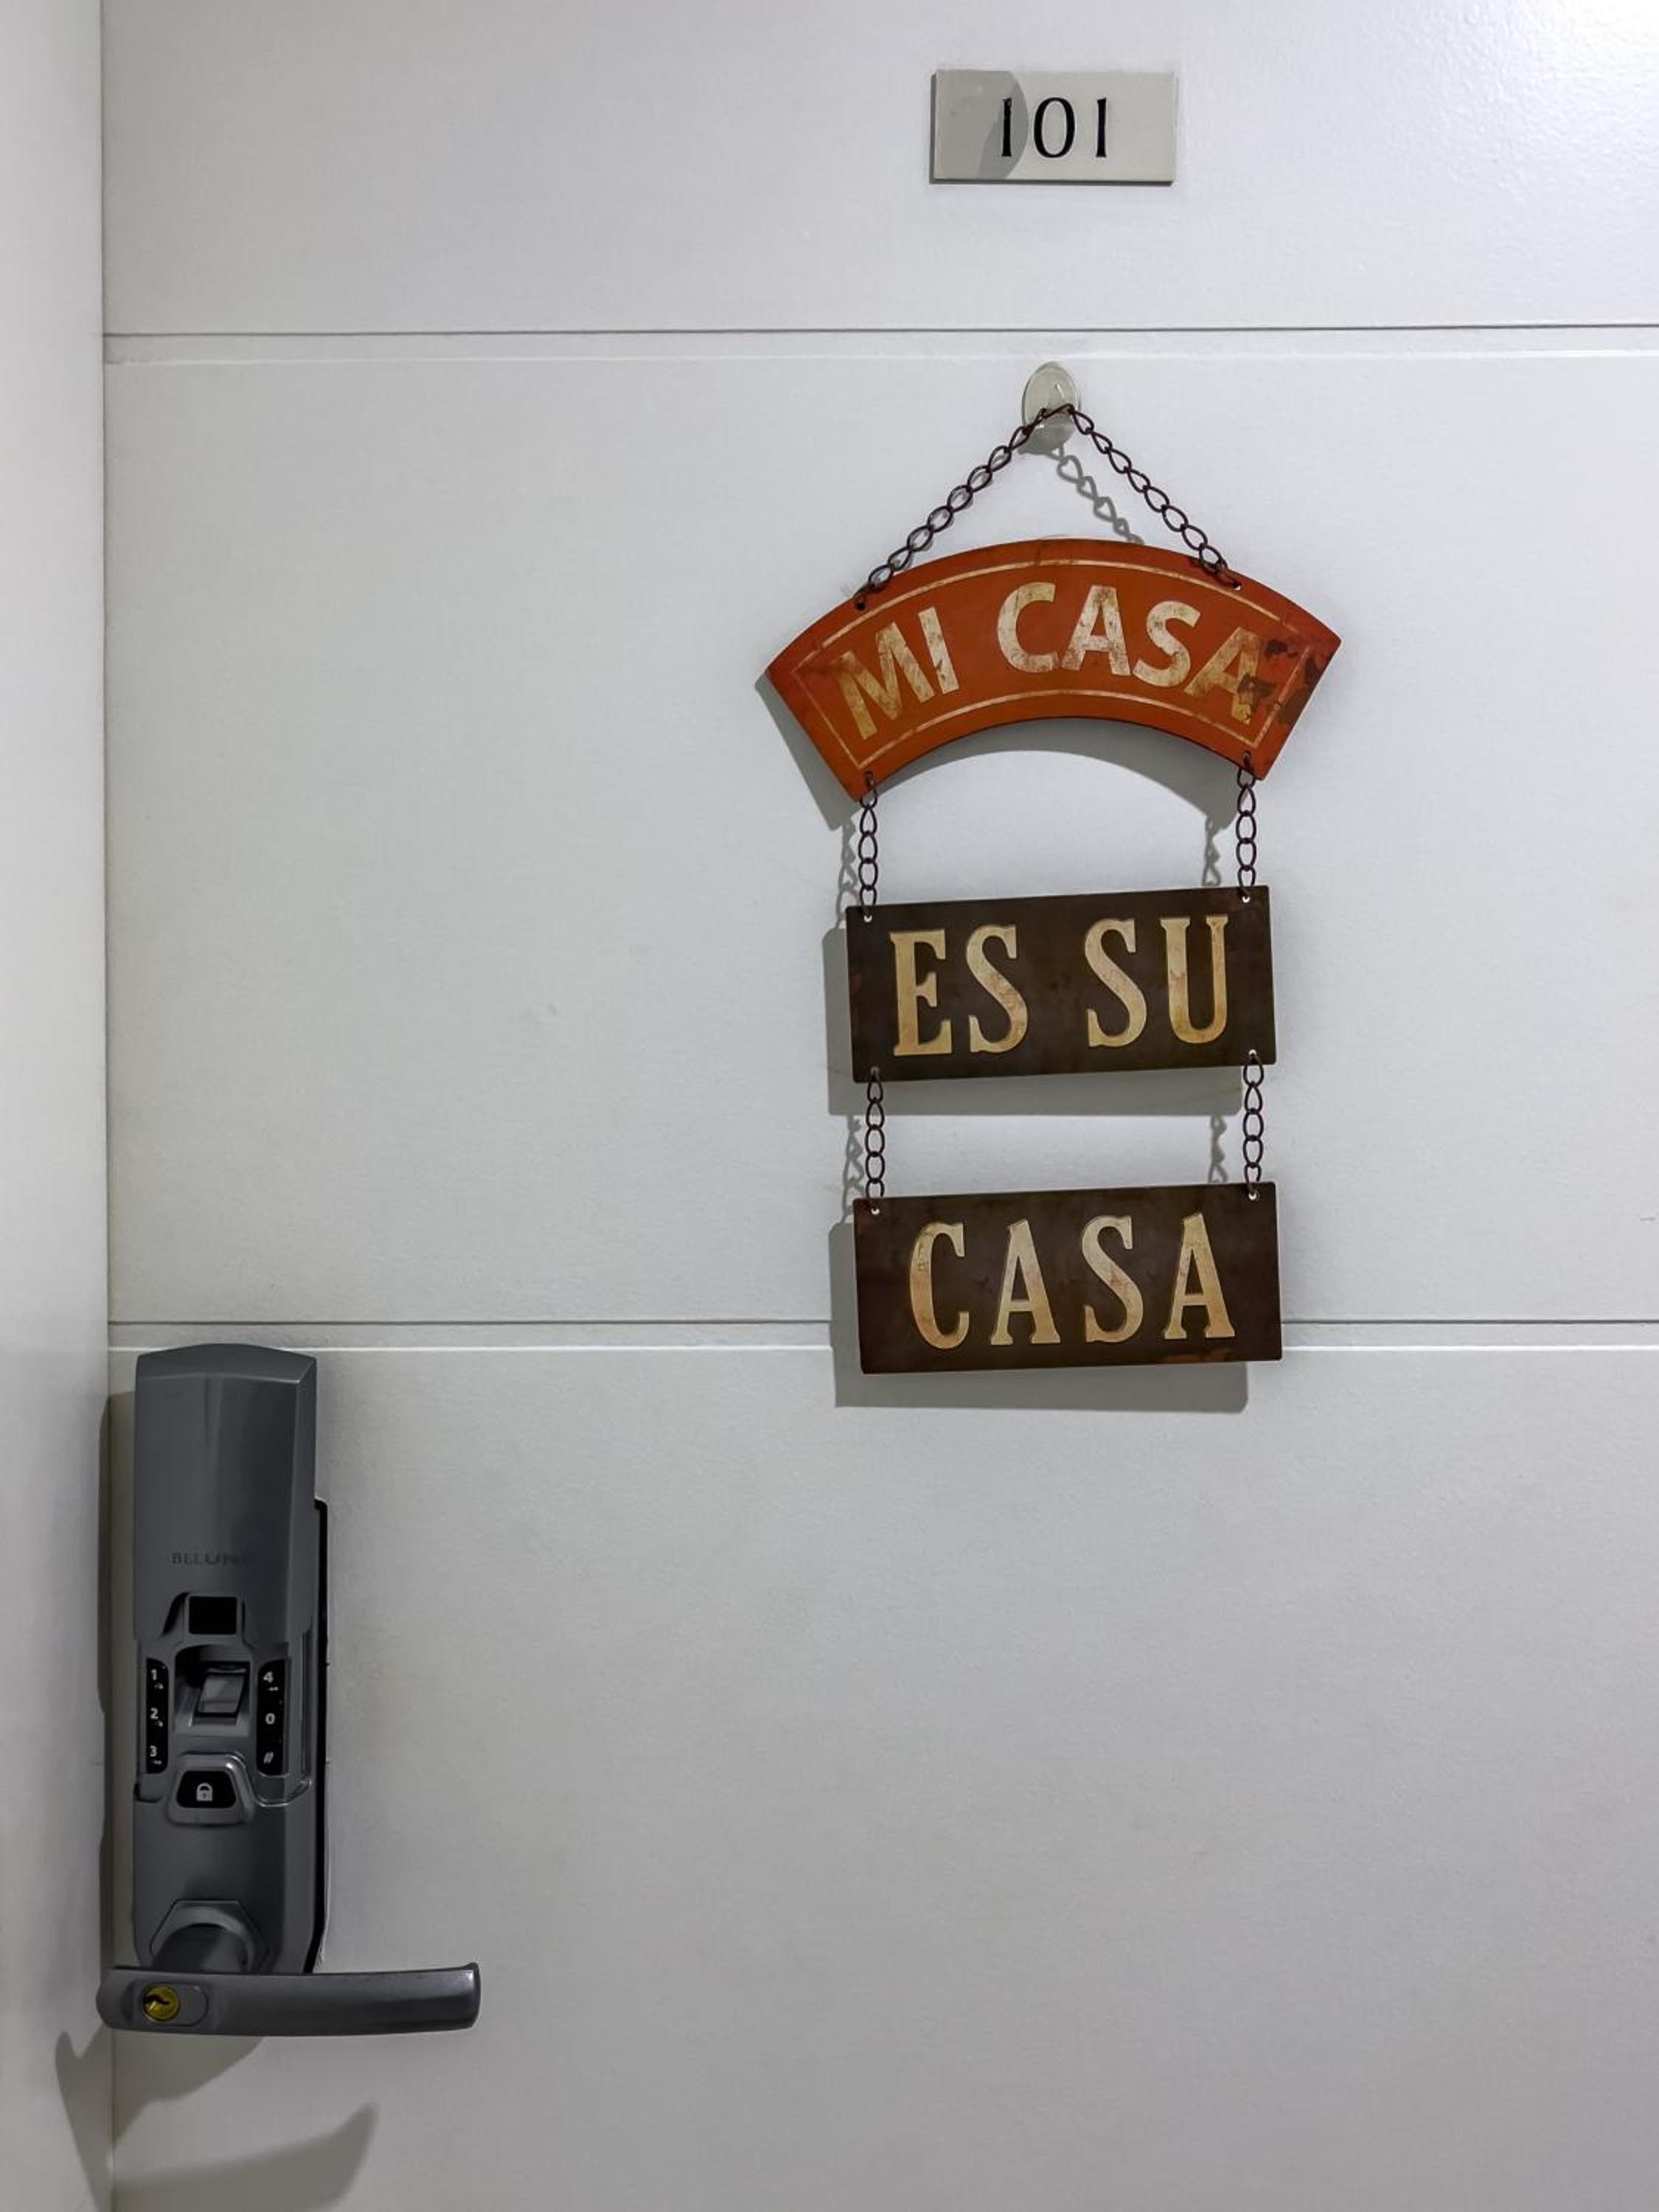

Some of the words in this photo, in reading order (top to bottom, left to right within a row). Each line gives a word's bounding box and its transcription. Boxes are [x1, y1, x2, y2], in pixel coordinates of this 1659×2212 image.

[1001, 97, 1107, 159] 101
[832, 607, 960, 740] MI
[997, 582, 1262, 726] CASA
[889, 925, 1029, 1057] ES
[1084, 914, 1229, 1048] SU
[908, 1213, 1236, 1349] CASA
[150, 1669, 157, 1680] 1
[262, 1671, 274, 1683] 4
[150, 1708, 159, 1719] 2
[265, 1712, 276, 1725] 0
[150, 1745, 157, 1757] 3
